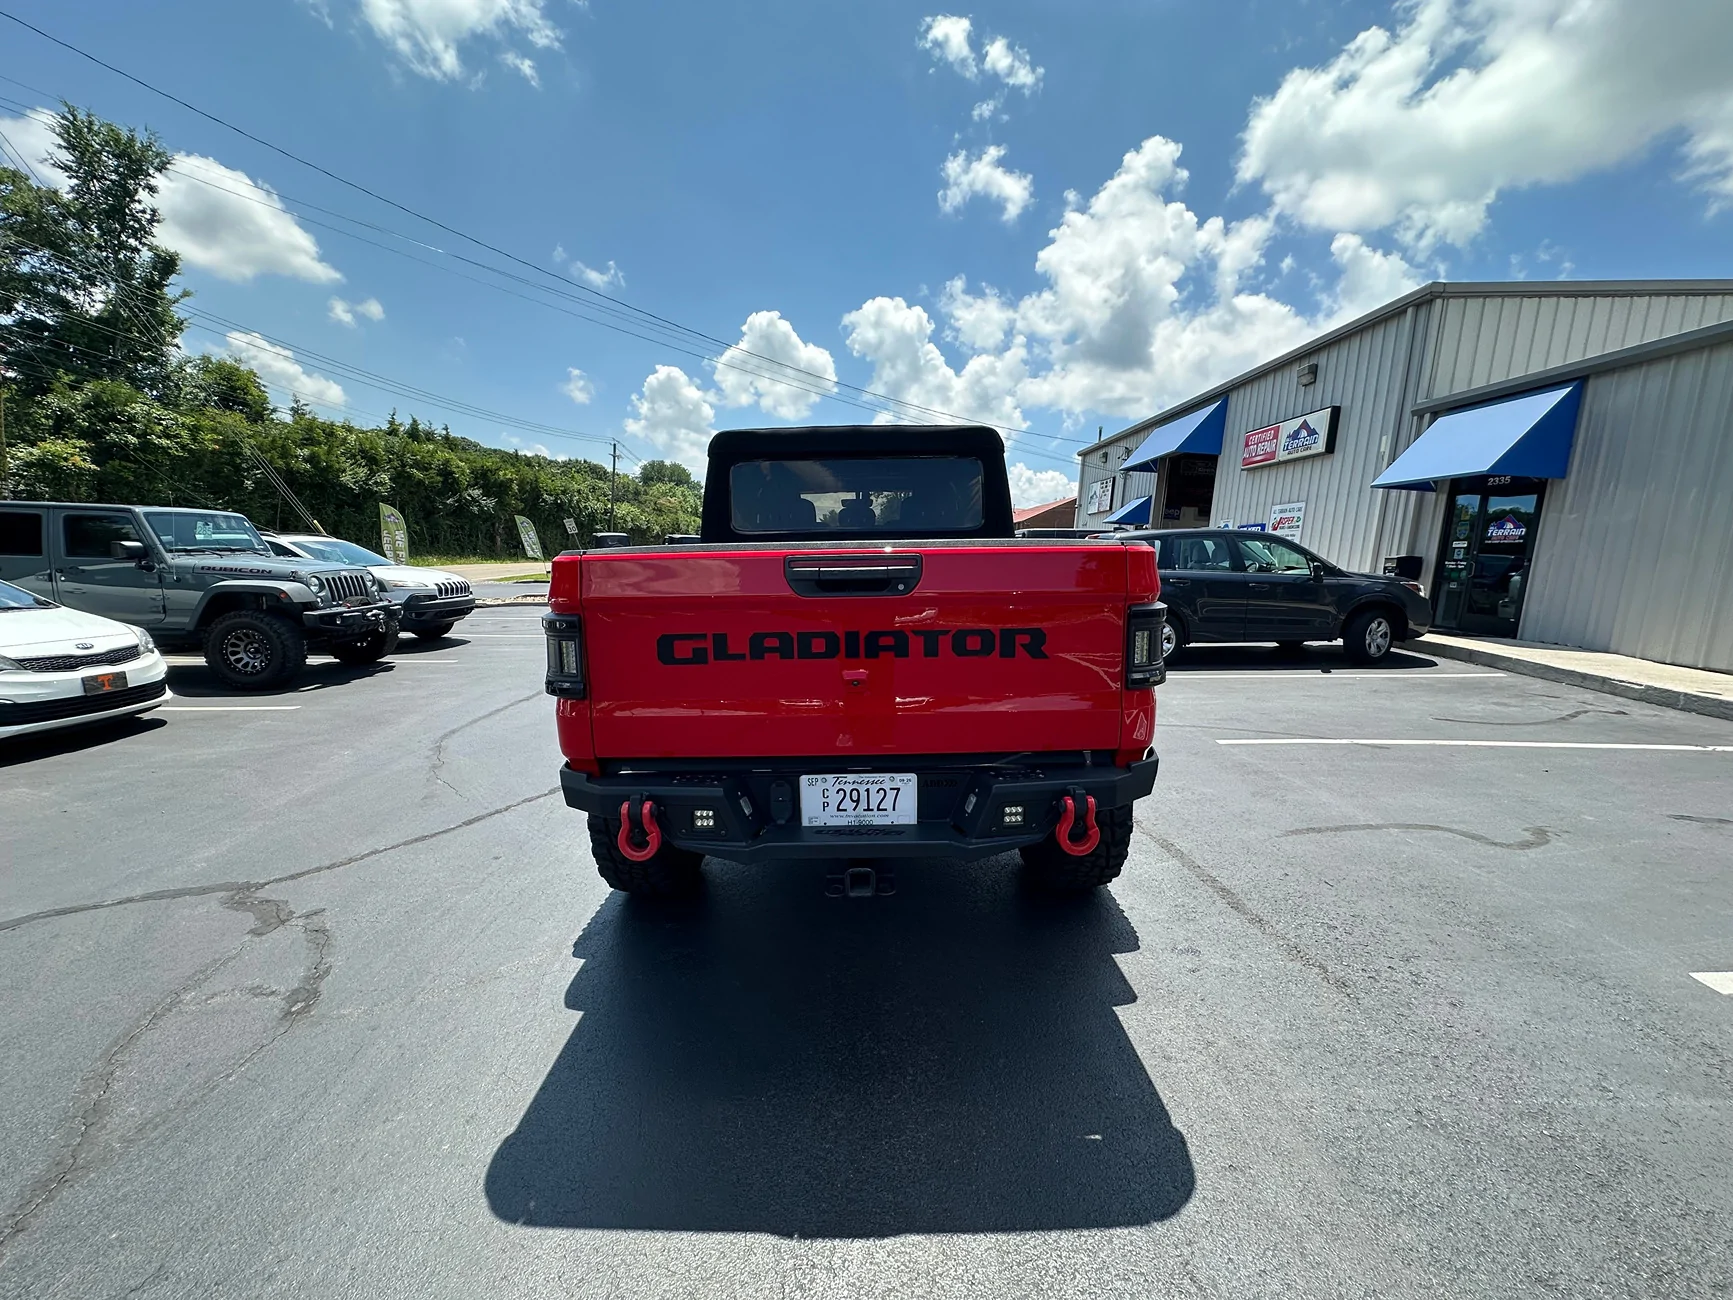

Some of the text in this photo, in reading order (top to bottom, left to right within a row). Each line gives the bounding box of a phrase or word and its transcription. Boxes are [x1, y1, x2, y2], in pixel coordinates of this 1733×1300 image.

[1248, 430, 1274, 445] CERTIFIED
[1284, 435, 1318, 451] TERRAIN
[1243, 439, 1277, 458] AUTO REPAIR
[1487, 476, 1511, 485] 2335
[567, 525, 577, 533] 30
[1487, 528, 1526, 536] TERRAIN
[200, 564, 273, 575] RUBICON
[656, 627, 1050, 666] GLADIATOR
[97, 674, 114, 691] T
[807, 777, 819, 787] SEP
[831, 776, 886, 787] Tennessee
[835, 787, 901, 812] 29127
